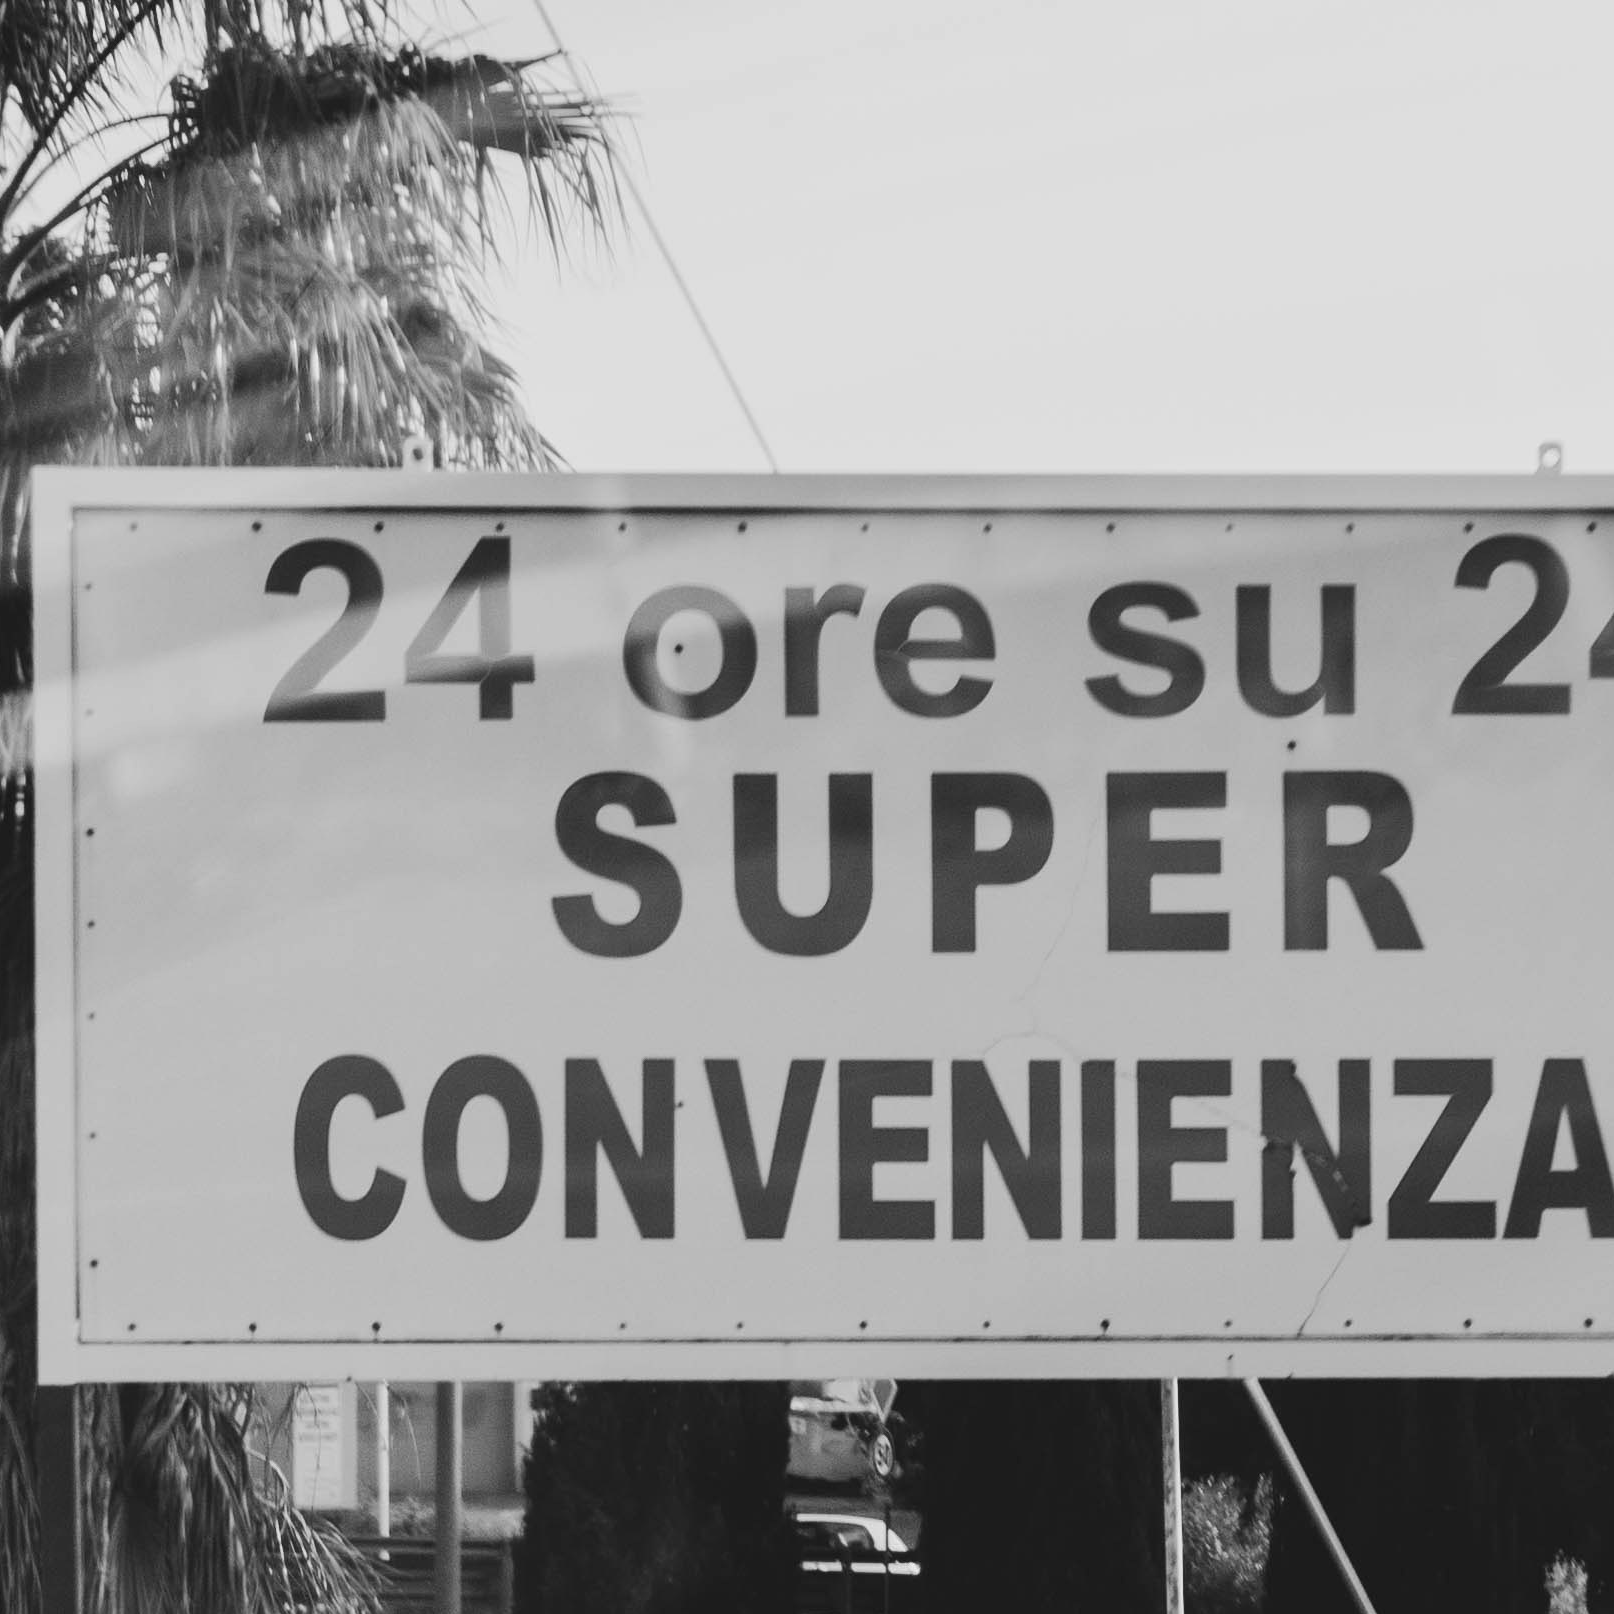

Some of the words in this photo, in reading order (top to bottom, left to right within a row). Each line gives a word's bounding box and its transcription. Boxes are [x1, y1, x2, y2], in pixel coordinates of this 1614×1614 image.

[262, 535, 536, 724] 24
[621, 580, 997, 721] ore
[1084, 580, 1357, 720] su
[551, 769, 1425, 959] SUPER
